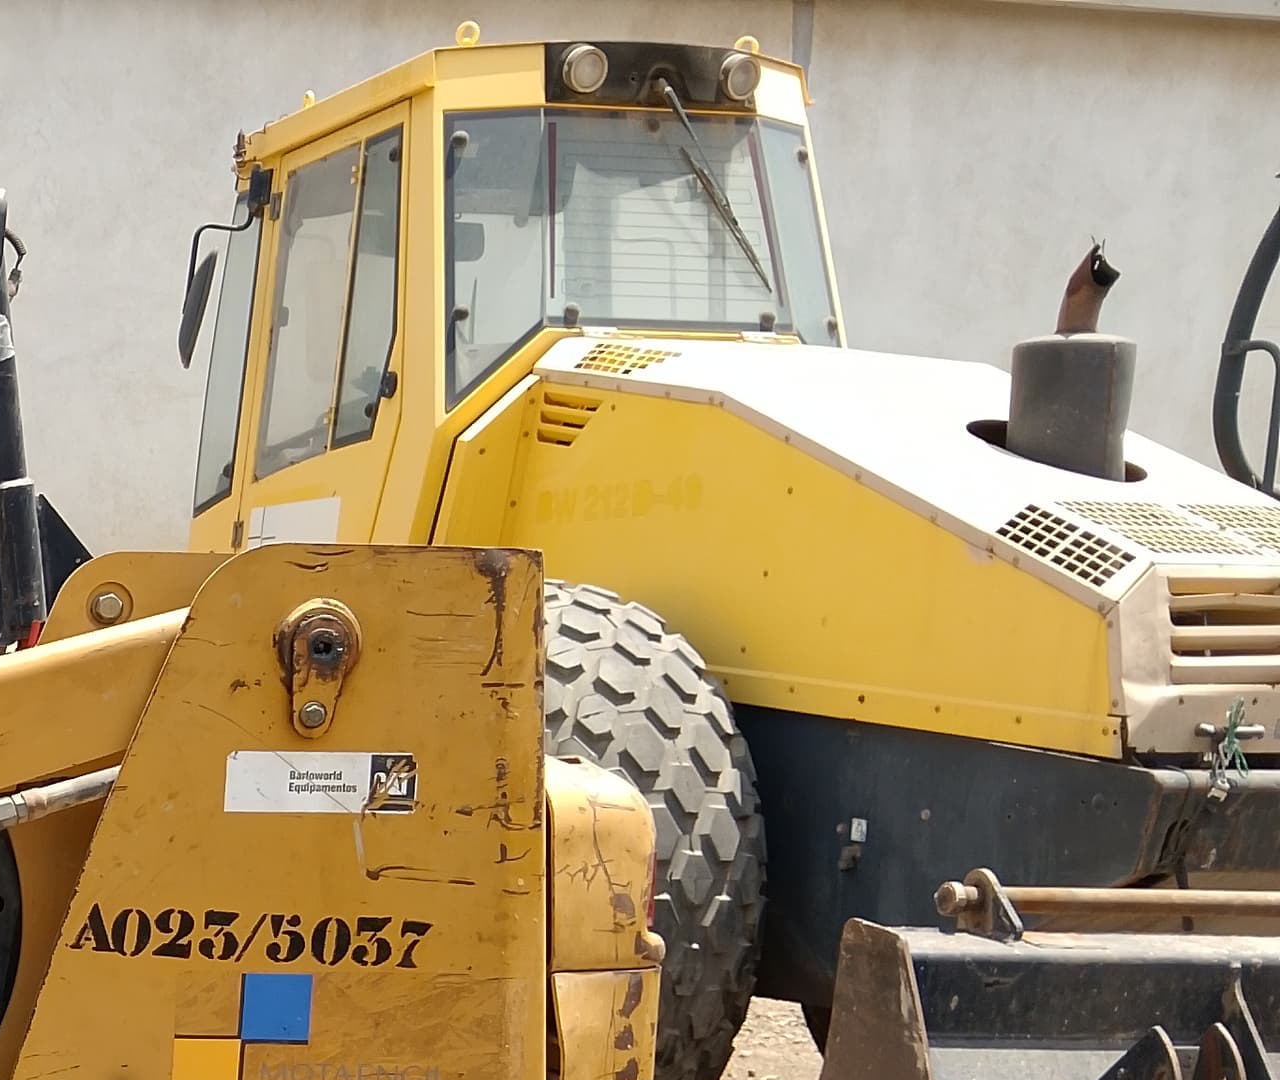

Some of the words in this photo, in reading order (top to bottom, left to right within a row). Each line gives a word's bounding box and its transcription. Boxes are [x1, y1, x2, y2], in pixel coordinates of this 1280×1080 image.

[289, 770, 343, 781] Barloworld
[288, 782, 358, 794] Equipamentos
[69, 902, 434, 970] A023/5037
